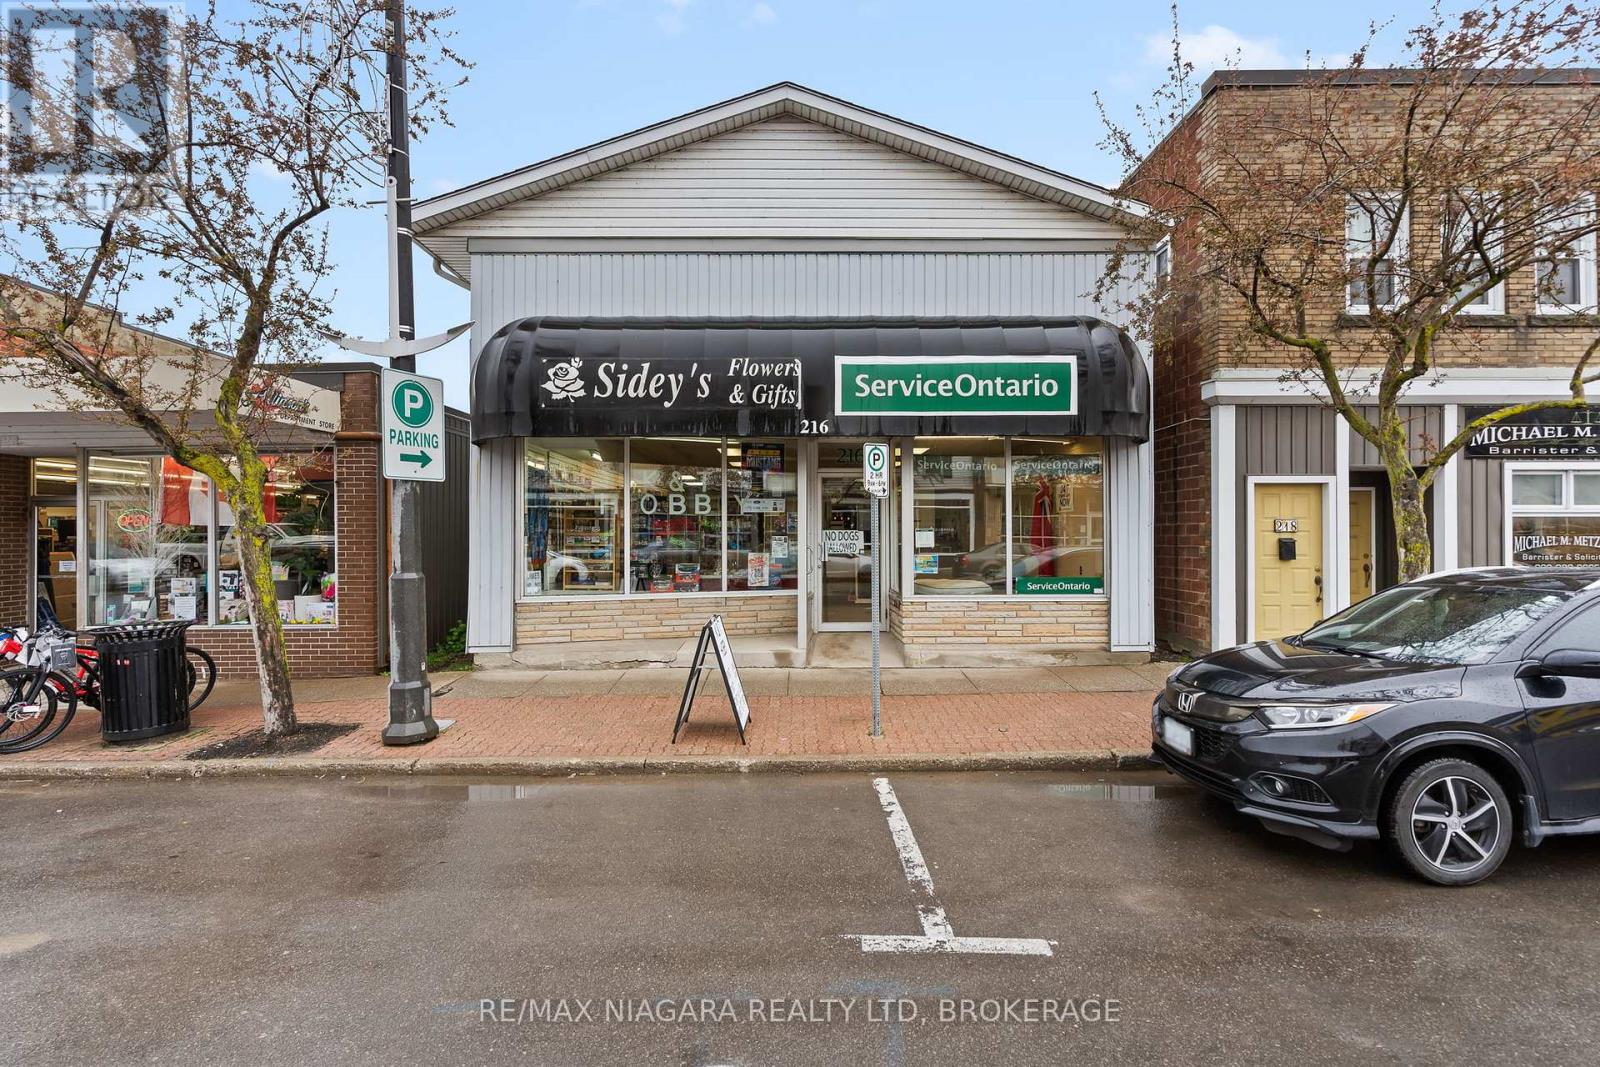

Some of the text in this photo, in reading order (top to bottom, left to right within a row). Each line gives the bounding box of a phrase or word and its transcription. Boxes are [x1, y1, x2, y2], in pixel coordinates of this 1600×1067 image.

[727, 358, 800, 378] Flowers
[593, 361, 712, 408] Sidey's
[855, 373, 1059, 397] ServiceOntario
[404, 388, 424, 417] P
[728, 383, 797, 410] & Gifts
[319, 420, 335, 430] STORE
[800, 418, 829, 434] 216
[389, 428, 439, 449] PARKING
[1470, 426, 1598, 447] MICHAEL M.
[1489, 446, 1598, 455] Barrister &
[873, 453, 880, 466] P
[917, 459, 998, 471] ServiceOntario
[120, 514, 150, 528] OPEN
[825, 531, 859, 541] NO DOGS
[828, 542, 857, 553] ALLOWED
[1513, 535, 1559, 554] MICHAEL
[1560, 535, 1572, 546] M.
[1027, 582, 1091, 590] ServiceOntario
